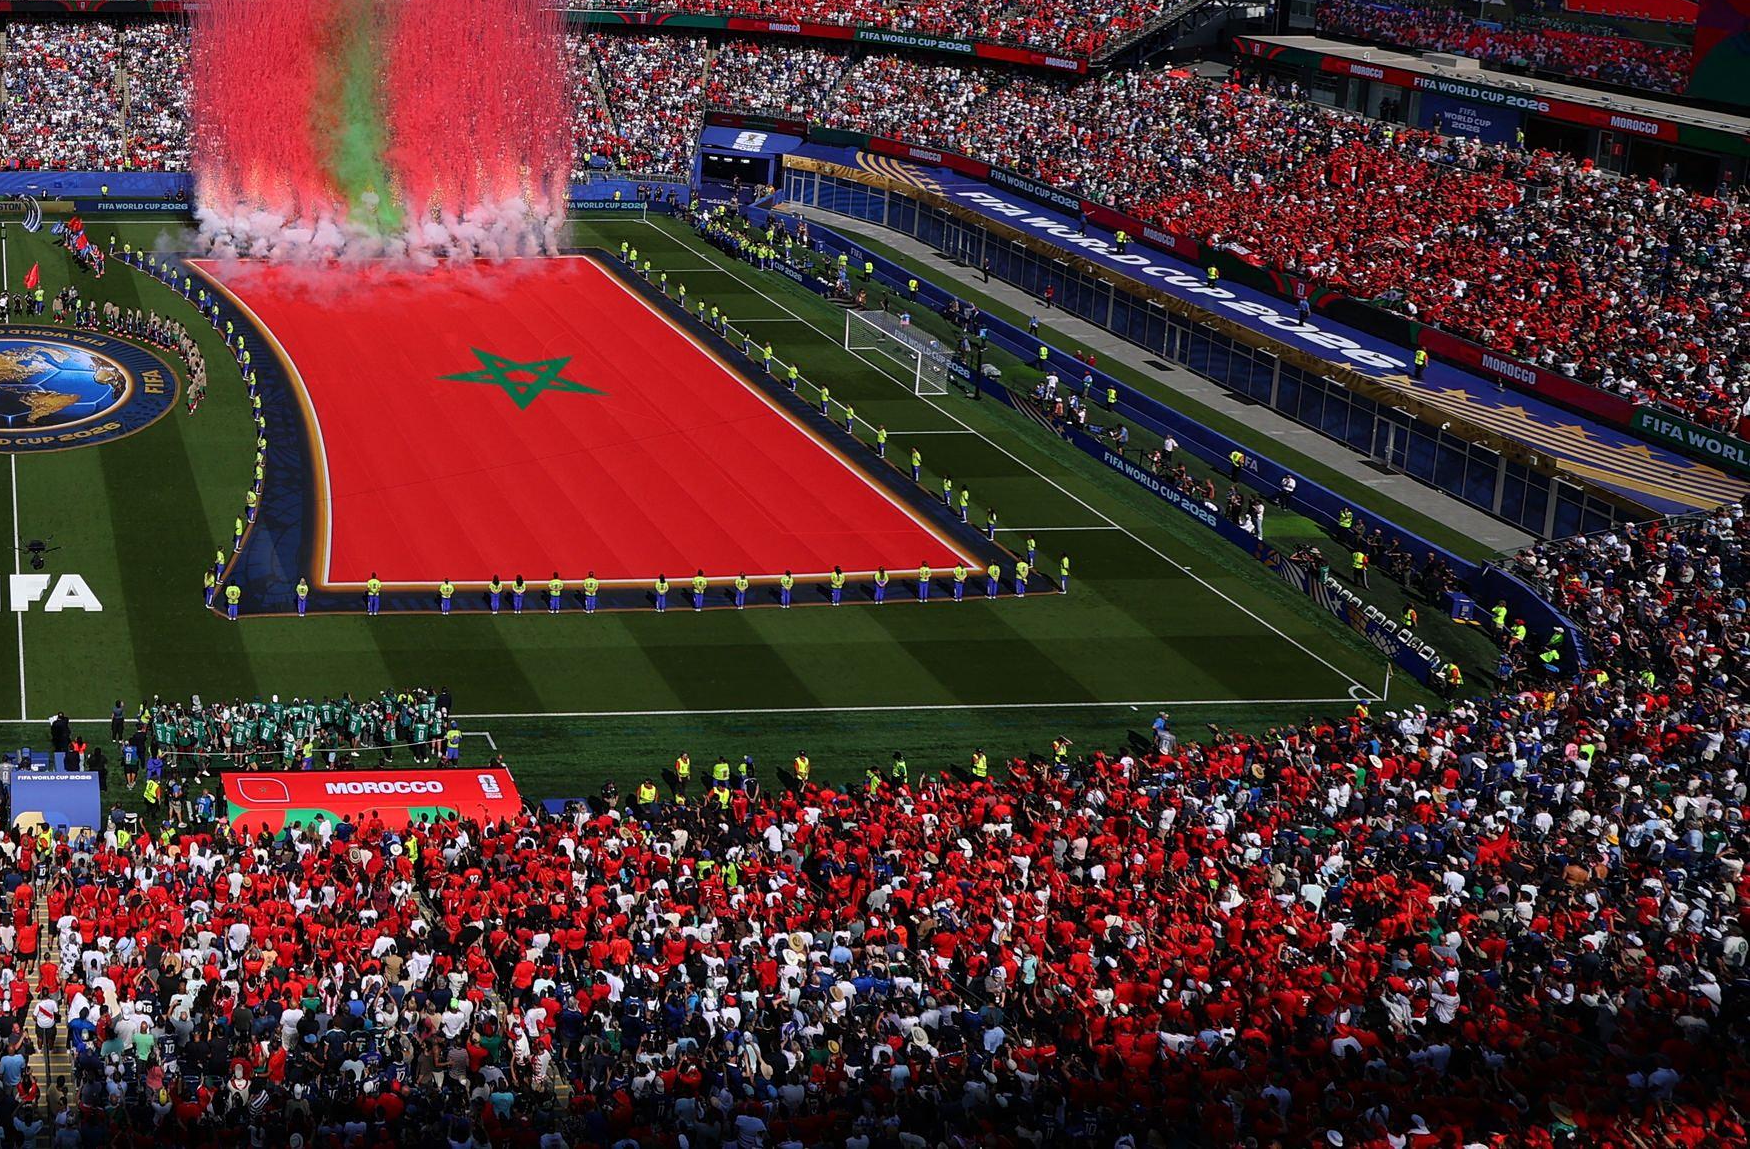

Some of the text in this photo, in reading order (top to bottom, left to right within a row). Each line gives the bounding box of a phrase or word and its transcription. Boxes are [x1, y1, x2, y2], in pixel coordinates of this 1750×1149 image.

[768, 23, 800, 32] MOROCCO
[860, 31, 971, 52] FIFA WORLD CUP 2026
[1045, 56, 1078, 70] MOROCCO
[1350, 65, 1384, 79] MOROCCO
[1414, 77, 1549, 113] FIFA WORLD CUP 2026
[1444, 111, 1491, 127] WORLD CUP
[1459, 108, 1476, 117] FIFA
[1451, 121, 1480, 133] 2026
[1610, 116, 1658, 134] MOROCCO
[909, 147, 942, 162] MOROCCO
[991, 169, 1079, 209] FIFA WORLD CUP 2026
[1144, 227, 1175, 247] MOROCCO
[955, 192, 1406, 368] FIFA WORLD CUP 2026
[8, 329, 107, 346] FIFA WORLD
[1482, 354, 1536, 385] MOROCCO
[141, 369, 164, 394] FIFA
[15, 436, 55, 445] CUP
[57, 422, 121, 441] 2026
[1642, 414, 1750, 467] FIFA WORL
[1104, 451, 1217, 527] FIFA WORLD CUP 2026
[325, 781, 444, 795] MOROCCO
[143, 1004, 153, 1013] 18
[165, 1044, 175, 1054] 10
[397, 1071, 405, 1082] 10
